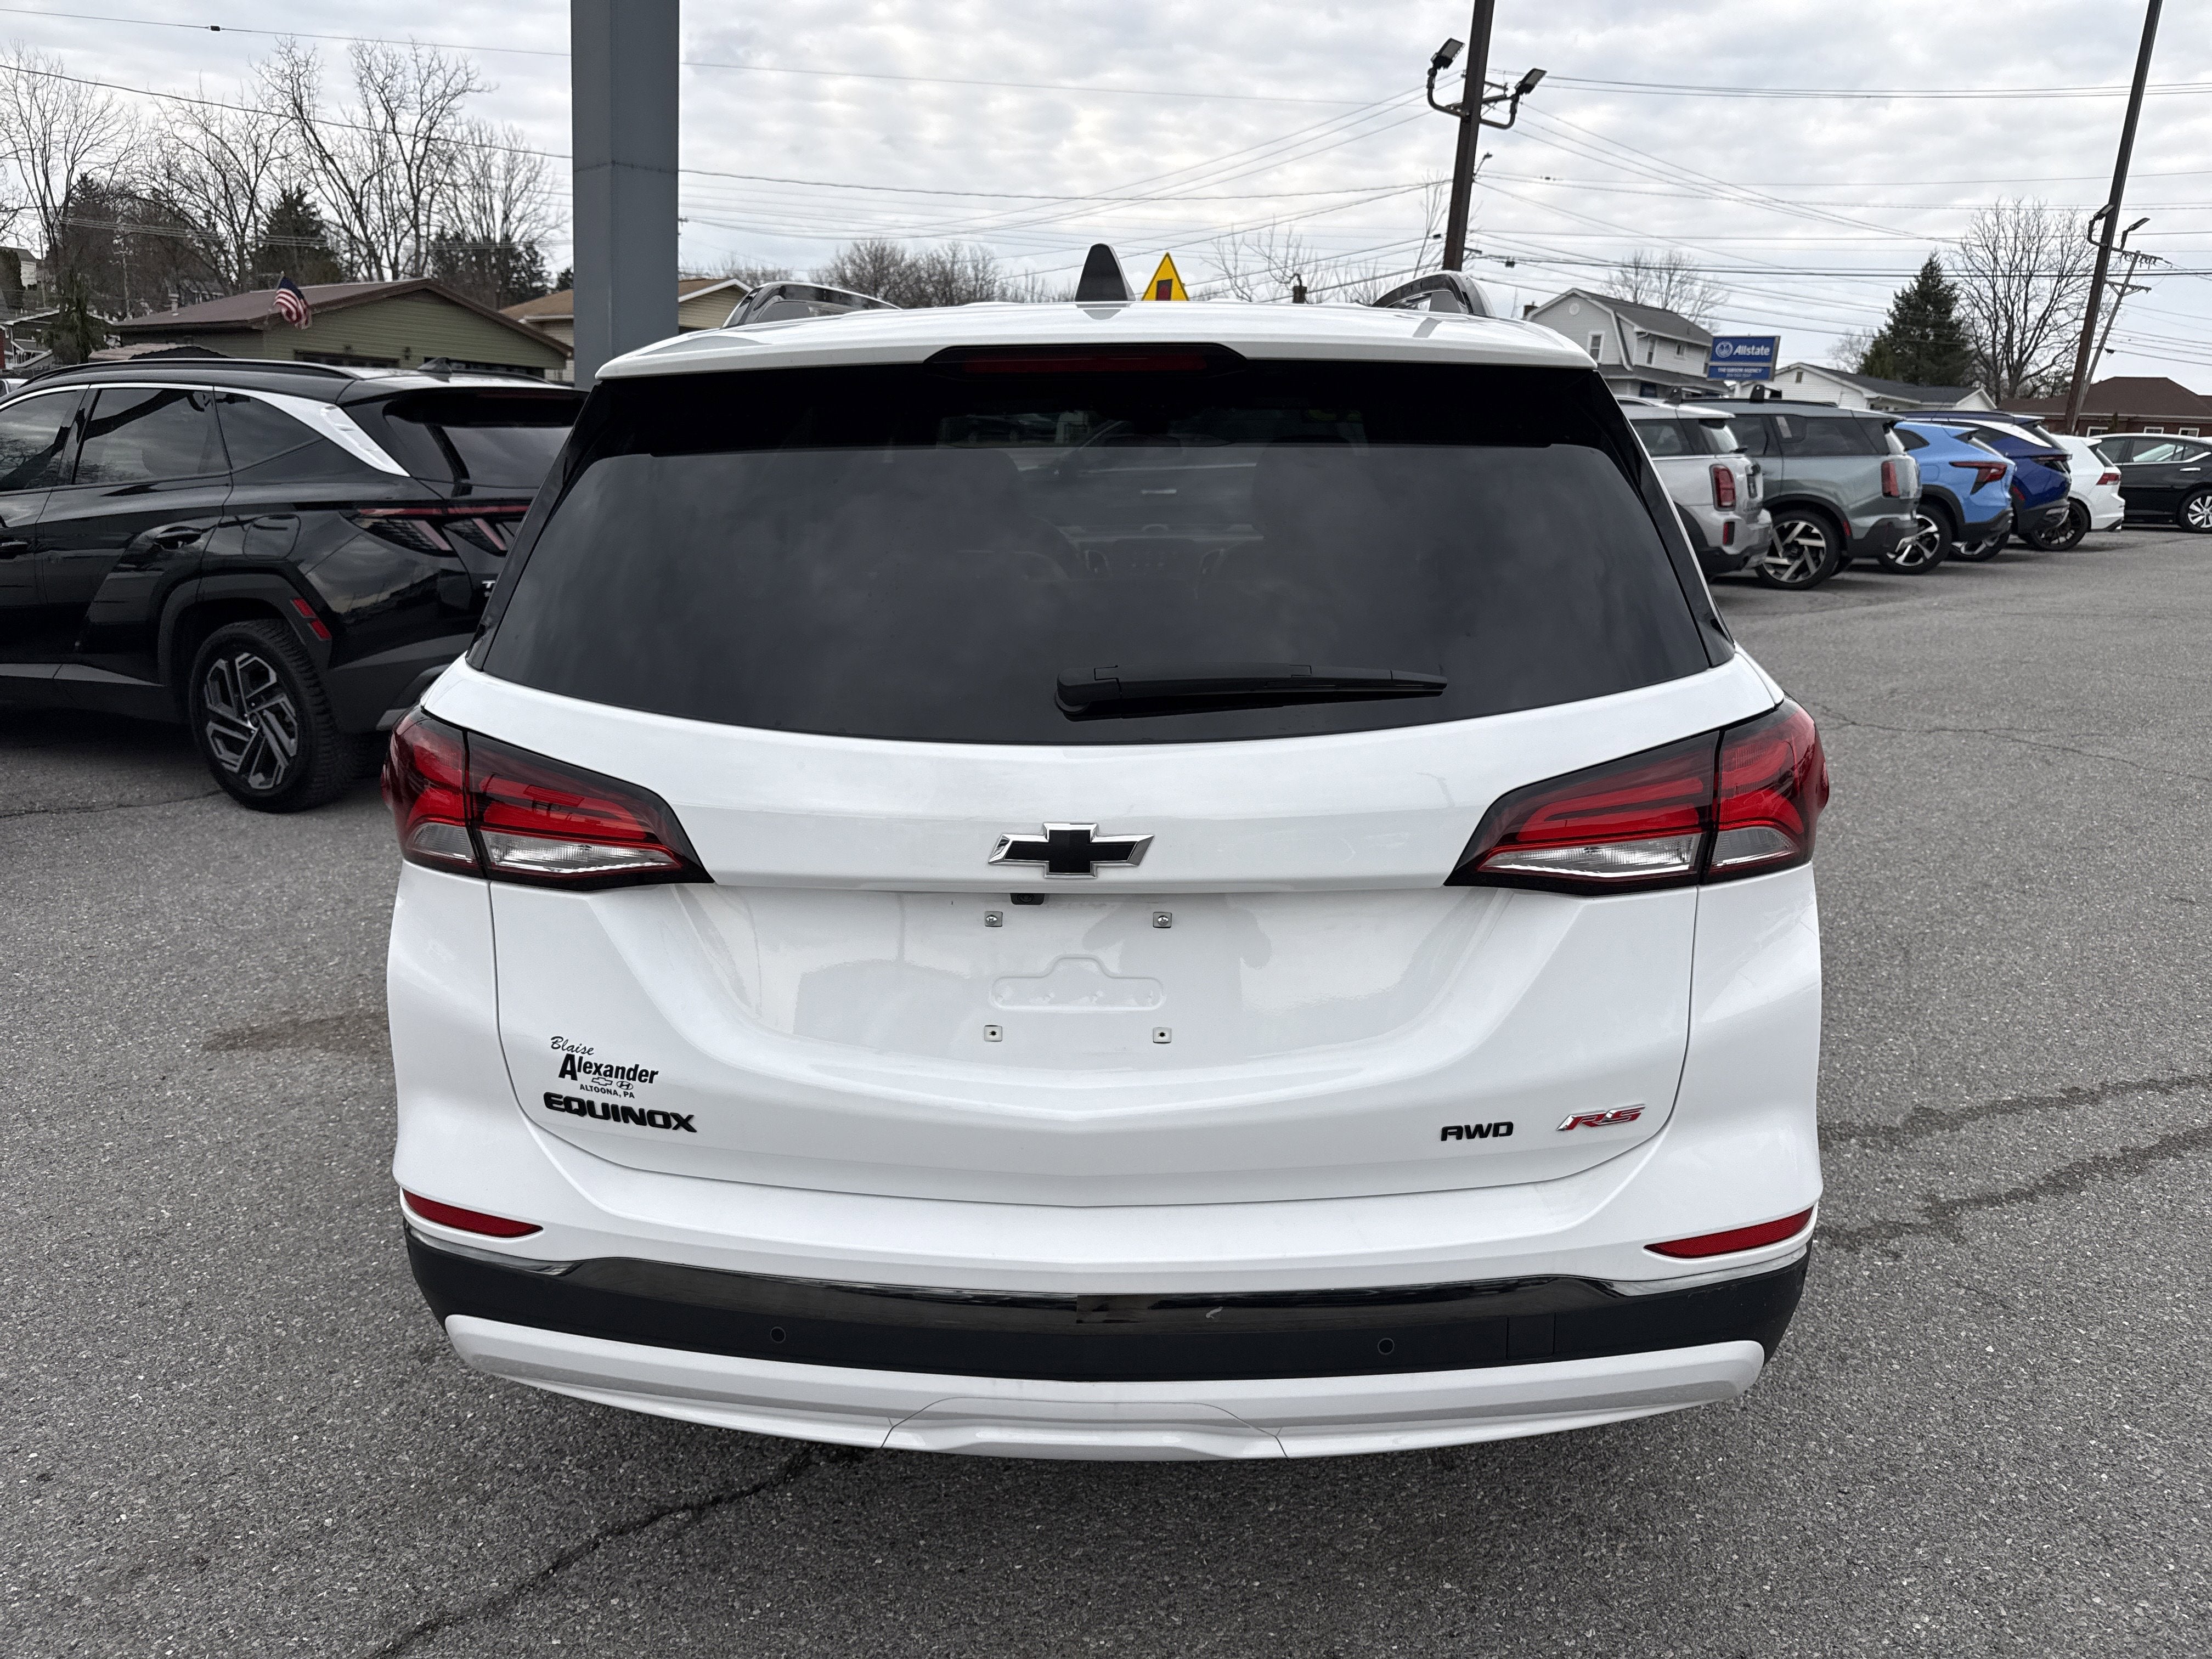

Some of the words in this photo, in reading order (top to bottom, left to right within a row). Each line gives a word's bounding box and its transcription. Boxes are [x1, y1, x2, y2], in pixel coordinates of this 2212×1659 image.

[1733, 344, 1770, 356] Allstate
[550, 1035, 595, 1056] Blaise
[558, 1053, 659, 1084] Alexander
[579, 1084, 622, 1098] ALTOONA,
[623, 1091, 635, 1099] PA
[543, 1091, 697, 1133] EQUINOX
[1556, 1103, 1646, 1132] RS
[1441, 1121, 1514, 1141] AWD
